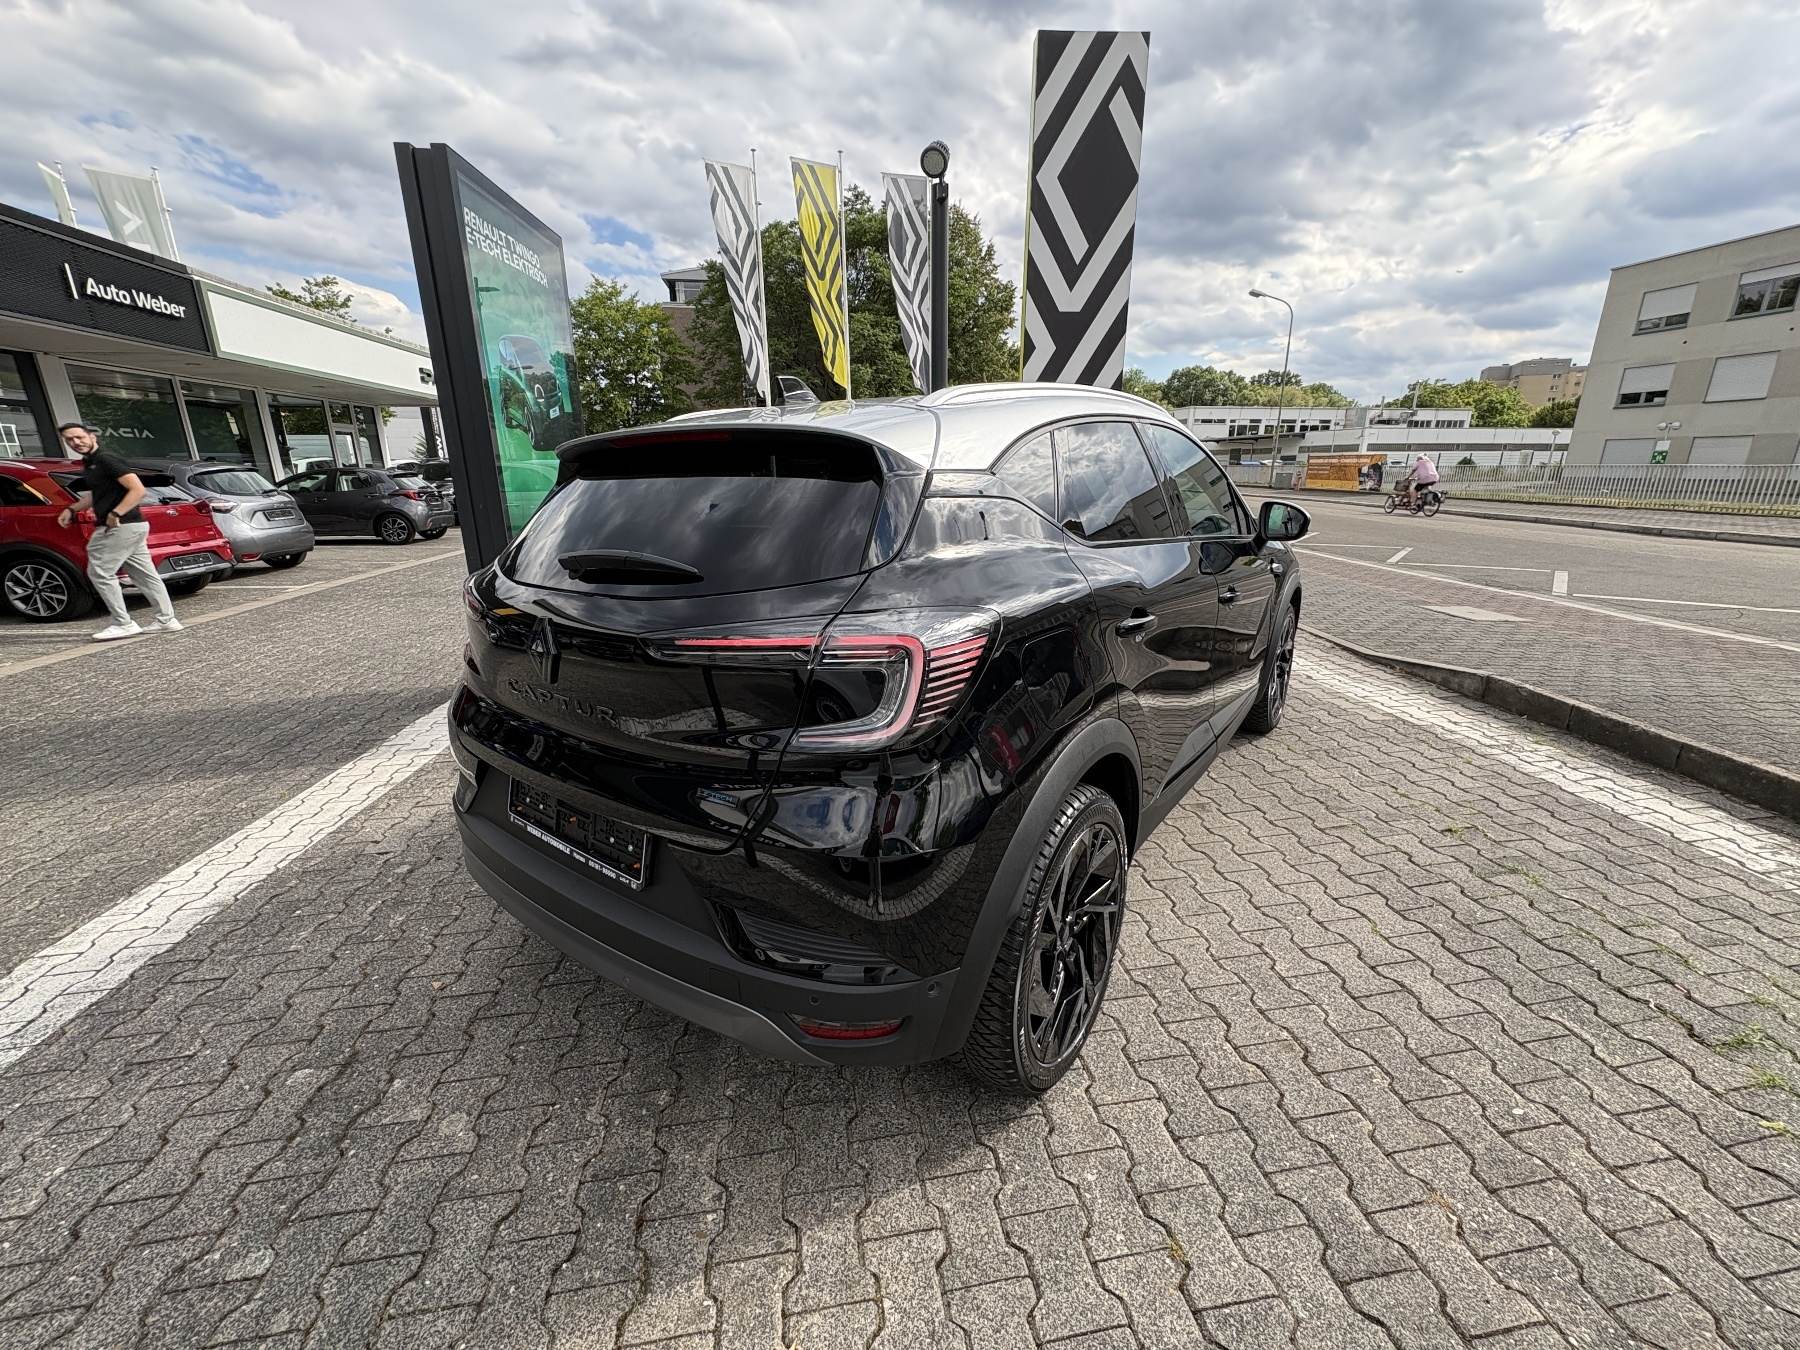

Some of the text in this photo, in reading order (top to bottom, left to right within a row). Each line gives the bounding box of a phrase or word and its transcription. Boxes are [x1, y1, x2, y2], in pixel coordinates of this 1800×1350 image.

[463, 206, 541, 268] RENAULT TWINGO
[465, 226, 549, 289] E-TECH ELEKTRISCH
[86, 277, 186, 318] Auto Weber
[508, 677, 619, 728] CAPTUR
[526, 824, 542, 839] WEBER
[541, 833, 571, 855] AUTOMOBILE
